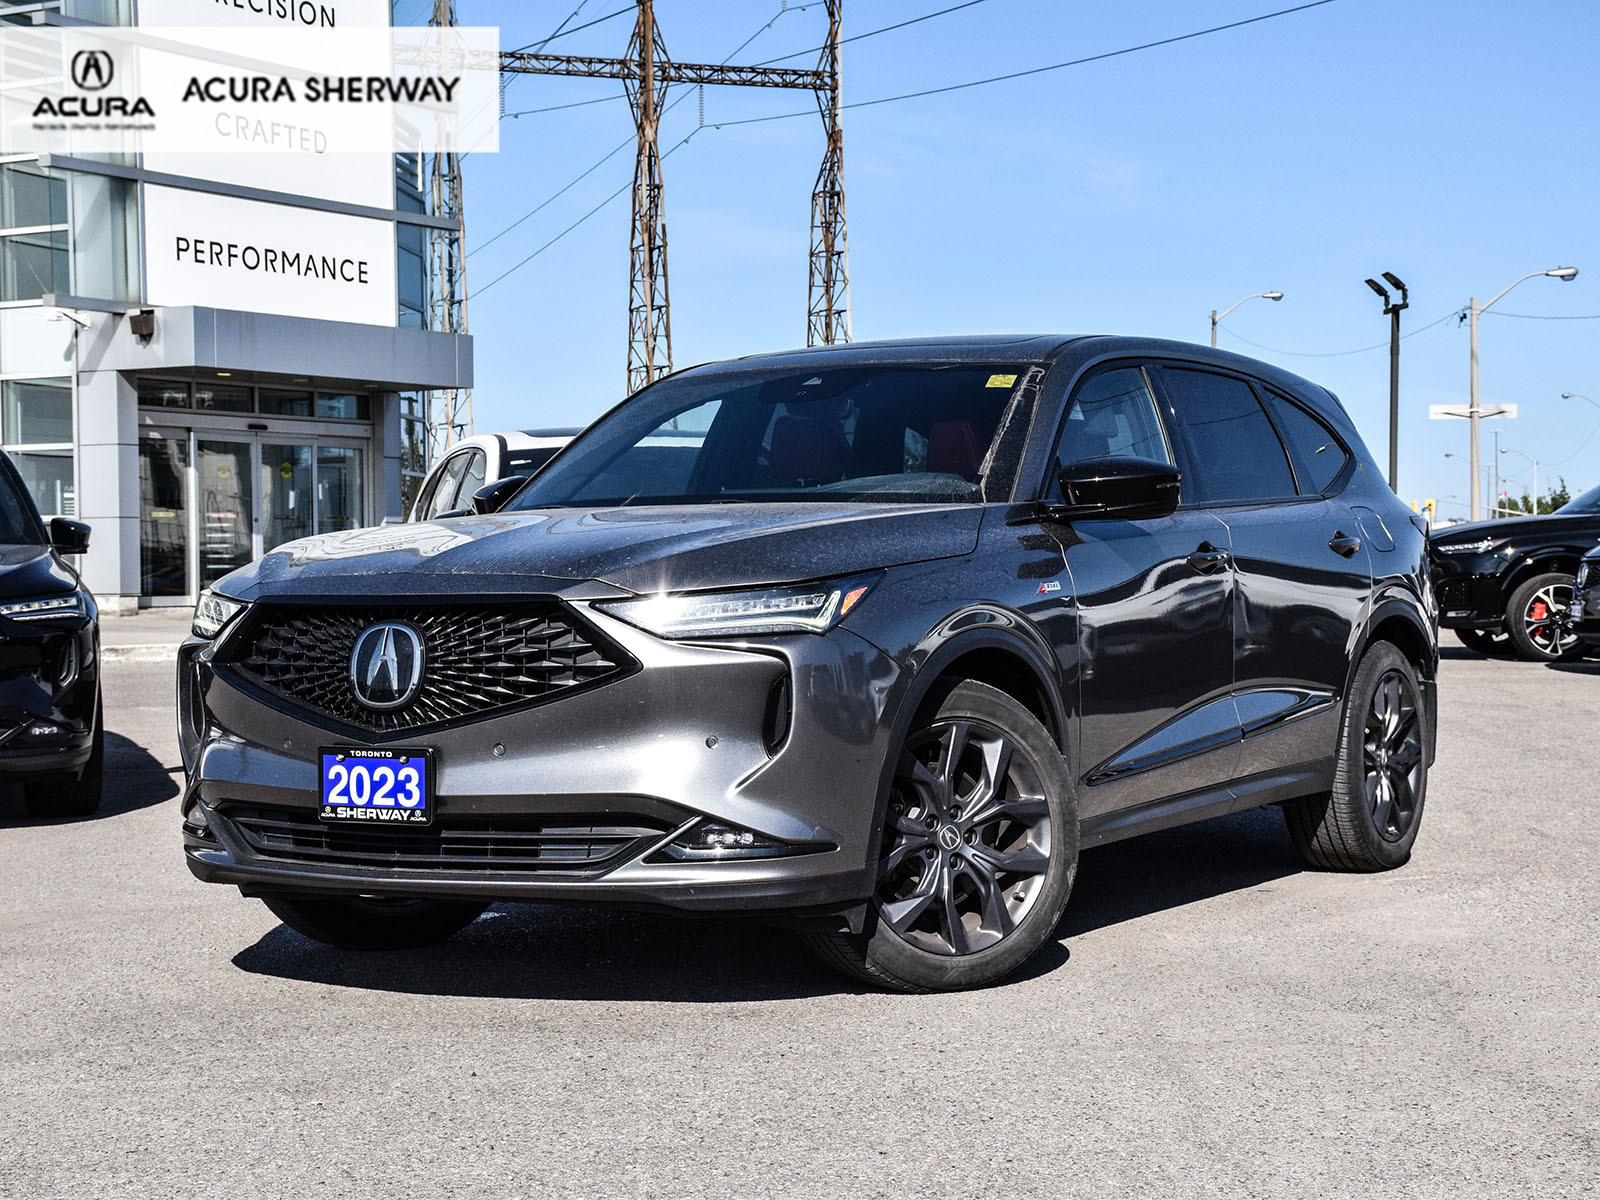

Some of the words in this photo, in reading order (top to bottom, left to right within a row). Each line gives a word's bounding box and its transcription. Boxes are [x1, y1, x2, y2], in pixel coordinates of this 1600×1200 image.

[215, 0, 335, 28] CISION
[215, 112, 328, 154] CRAFTED
[176, 237, 369, 284] PERFORMANCE
[350, 750, 393, 758] TORONTO
[328, 764, 421, 808] 2023
[336, 806, 412, 821] SHERWAY
